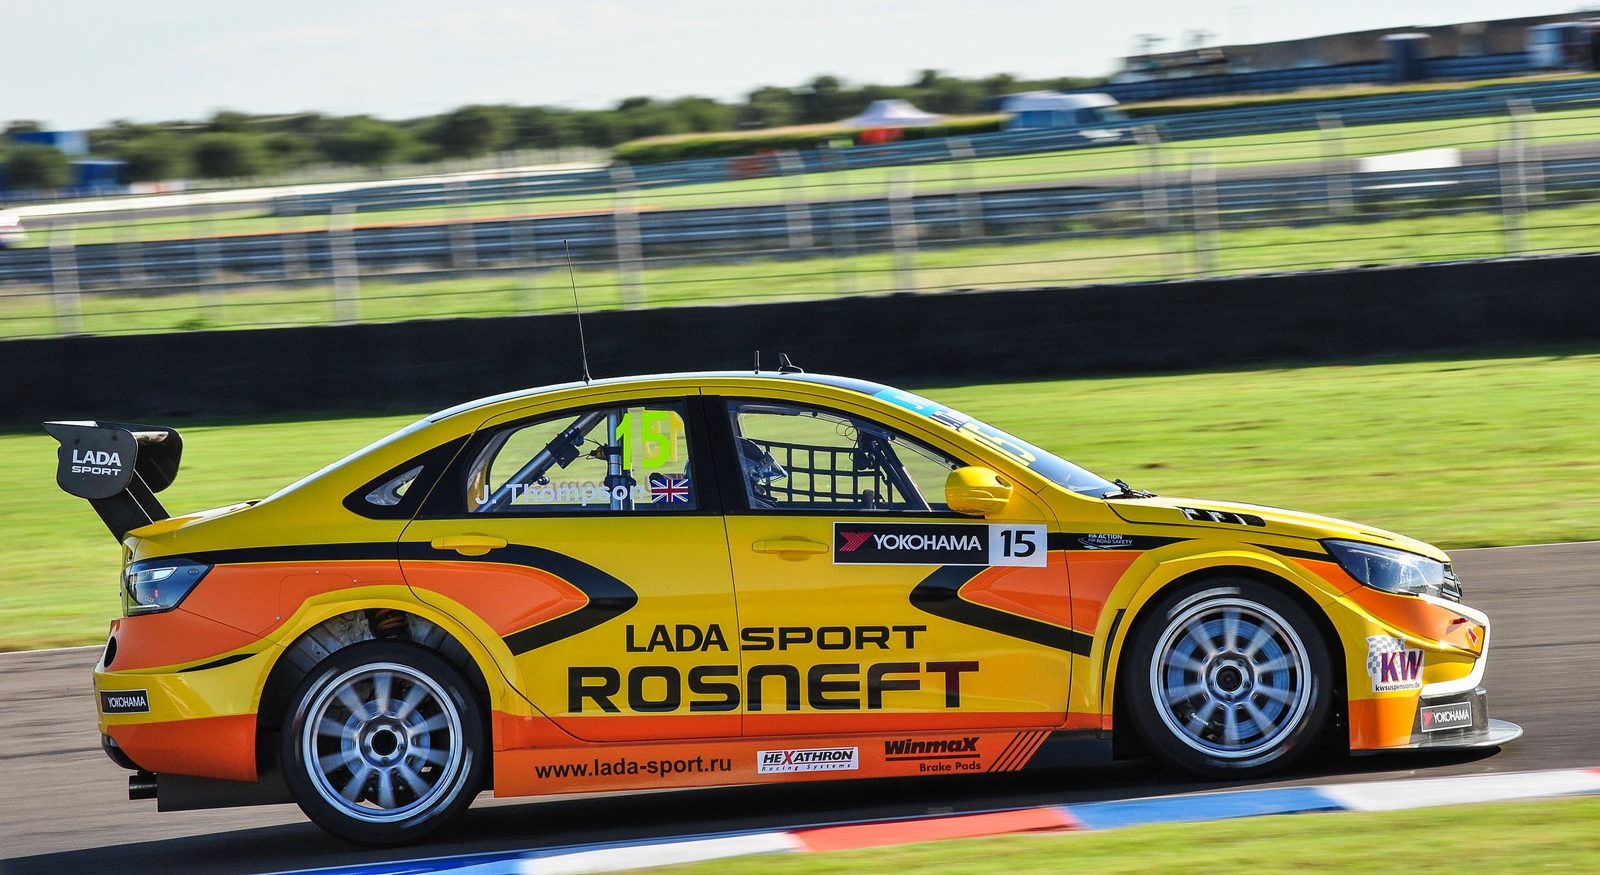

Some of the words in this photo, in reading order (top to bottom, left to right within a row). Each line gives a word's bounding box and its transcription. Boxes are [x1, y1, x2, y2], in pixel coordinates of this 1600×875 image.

[616, 410, 671, 471] 15
[72, 449, 122, 467] LADA
[71, 466, 122, 476] SPORT
[475, 484, 497, 505] J.
[506, 483, 644, 506] Thompson
[873, 533, 983, 552] YOKOHAMA
[1000, 529, 1036, 558] 15
[626, 623, 729, 652] LADA
[741, 625, 927, 651] SPORT
[1381, 650, 1424, 683] KW
[567, 661, 980, 713] ROSNEFT
[1375, 681, 1421, 692] kwsuspensions.de
[108, 696, 147, 708] YOKOHAMA
[1433, 708, 1471, 724] YOKOHAMA
[535, 748, 732, 779] www.lada-sport.ru
[763, 750, 854, 765] HEXATHRON
[919, 762, 952, 772] Brake
[955, 760, 982, 771] Pads
[806, 763, 852, 771] Systems
